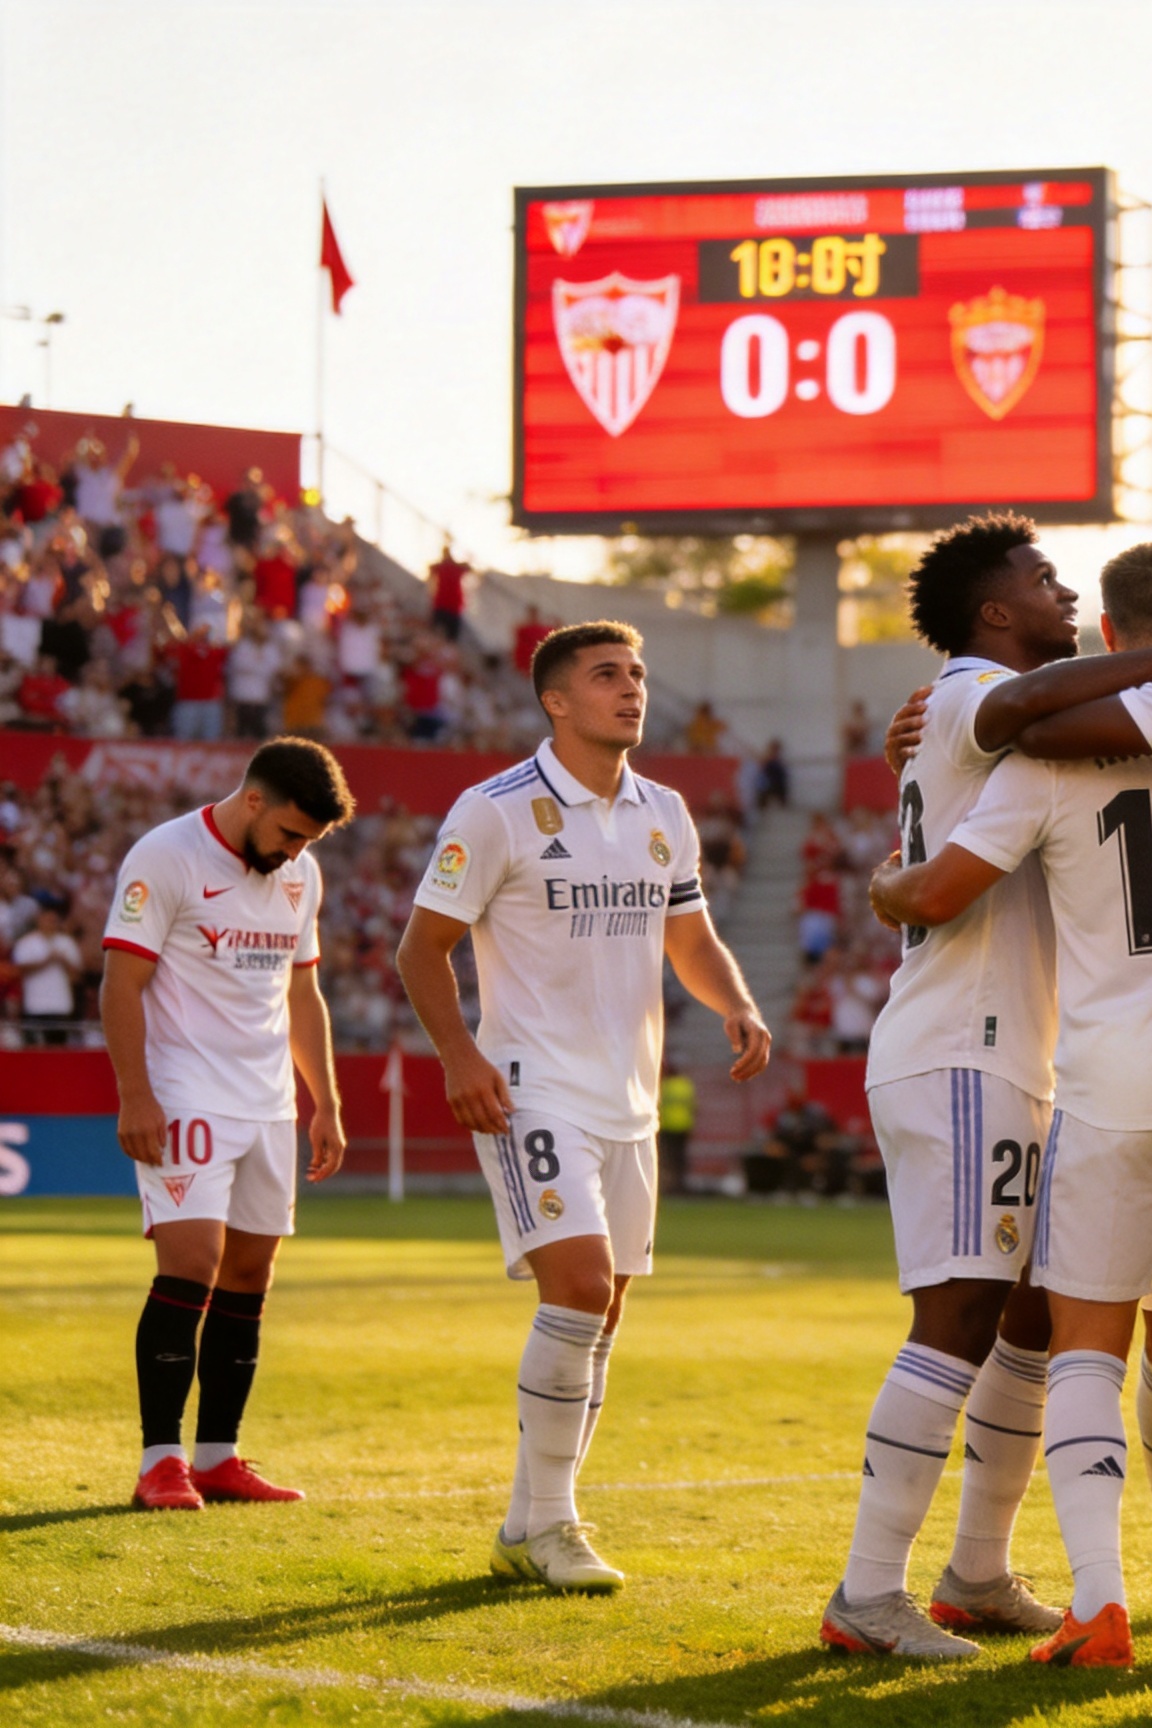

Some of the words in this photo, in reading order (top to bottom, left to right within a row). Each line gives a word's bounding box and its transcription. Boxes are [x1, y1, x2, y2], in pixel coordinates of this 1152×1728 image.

[720, 310, 897, 418] 0:0
[167, 1117, 213, 1165] 10
[524, 1128, 561, 1182] 8
[991, 1139, 1041, 1207] 20
